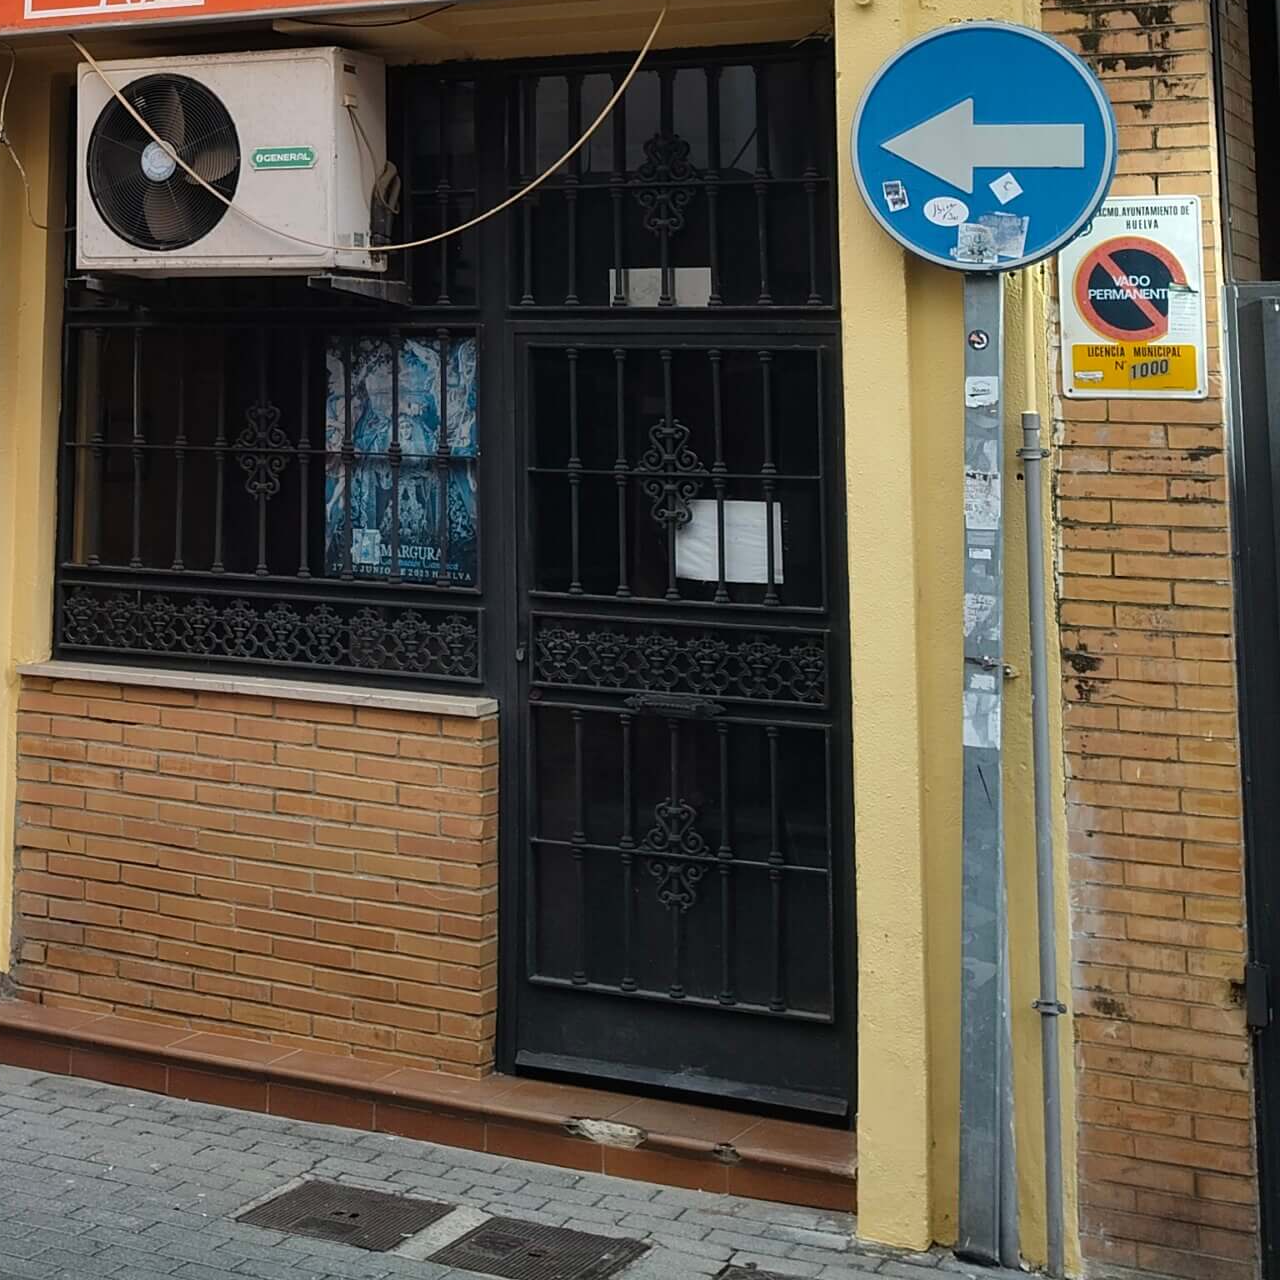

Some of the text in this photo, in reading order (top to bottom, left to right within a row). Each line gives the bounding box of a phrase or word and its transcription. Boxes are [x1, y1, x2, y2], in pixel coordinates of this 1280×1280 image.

[1180, 205, 1190, 216] DE
[1126, 219, 1159, 230] HUELVA
[1111, 275, 1151, 287] VADO
[1088, 288, 1169, 300] PERMANENT
[1087, 346, 1181, 358] LICENCIA MUNICIPAL
[1131, 359, 1169, 379] 1000
[360, 564, 391, 575] JUNIO
